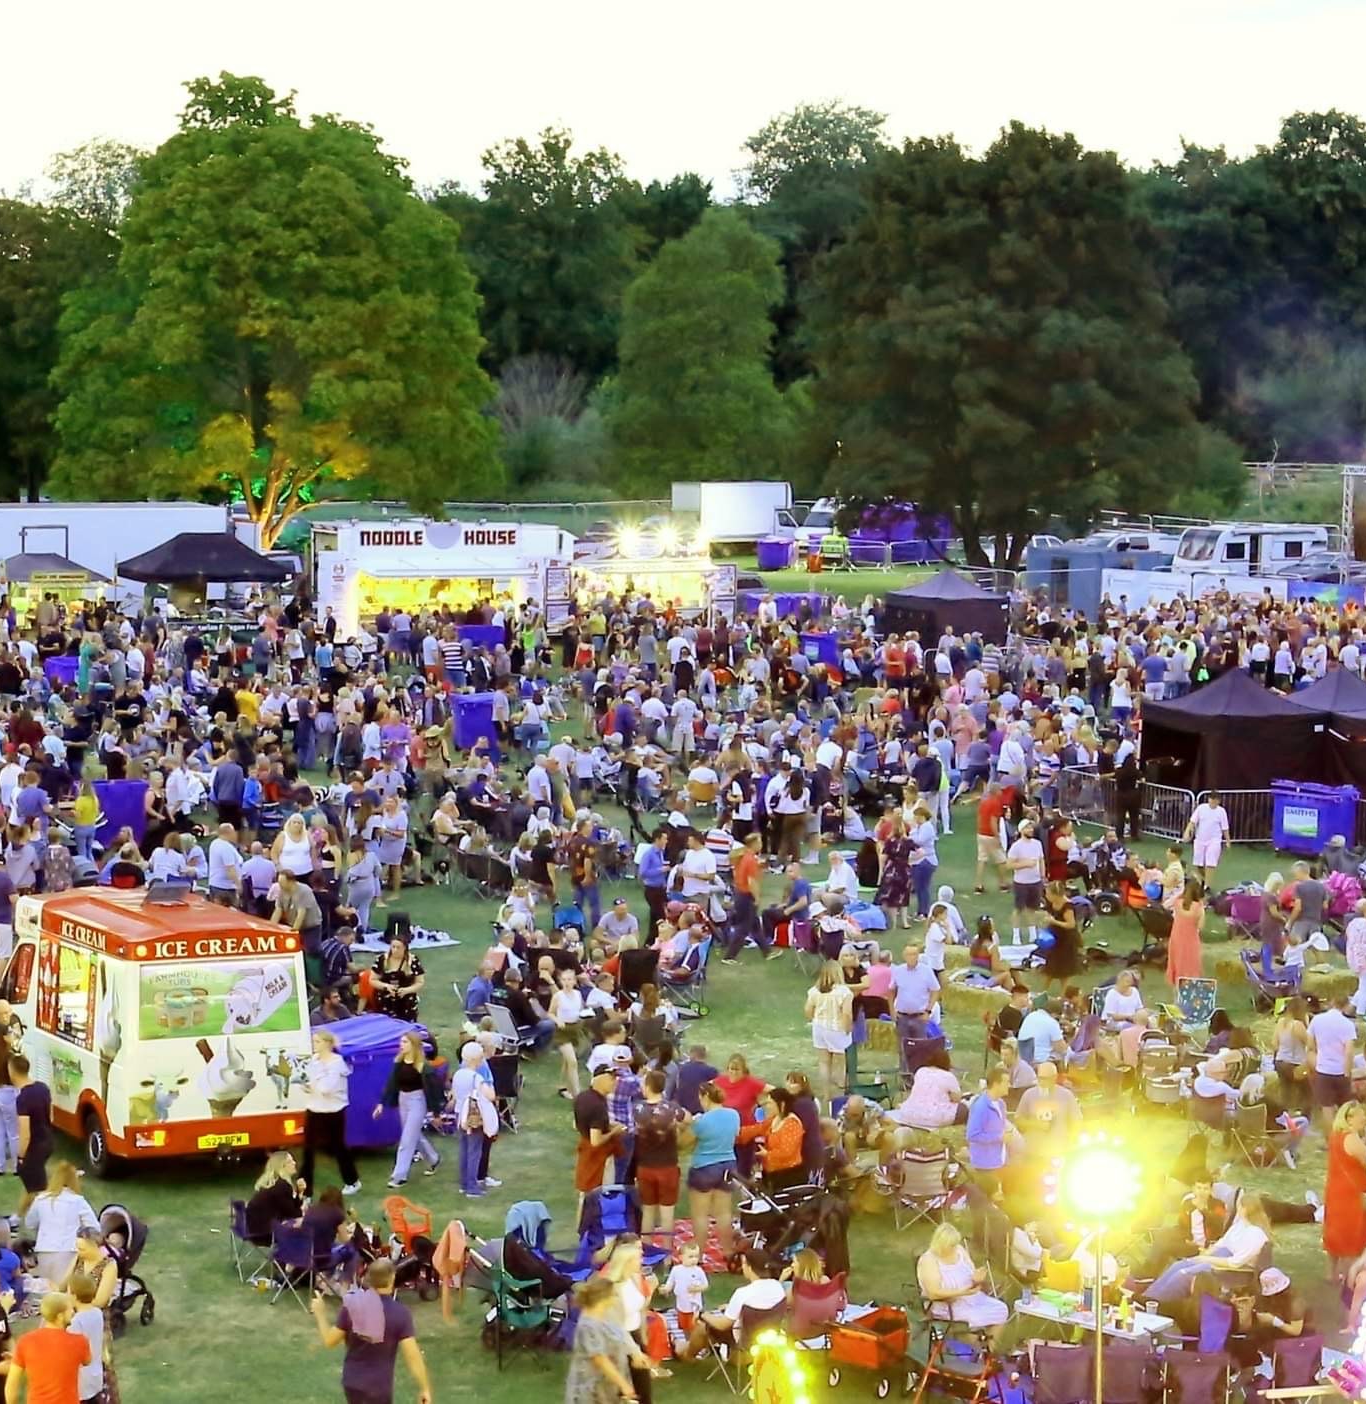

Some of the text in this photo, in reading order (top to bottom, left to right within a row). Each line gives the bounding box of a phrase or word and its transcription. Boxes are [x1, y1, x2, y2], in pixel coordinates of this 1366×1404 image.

[360, 530, 516, 546] NOODLE HOUSE
[1286, 808, 1317, 817] SMITHS
[61, 919, 75, 939] ICE
[75, 926, 106, 951] CREAM
[154, 936, 277, 958] ICE CREAM
[265, 977, 279, 992] MILK
[268, 980, 288, 999] CREAM
